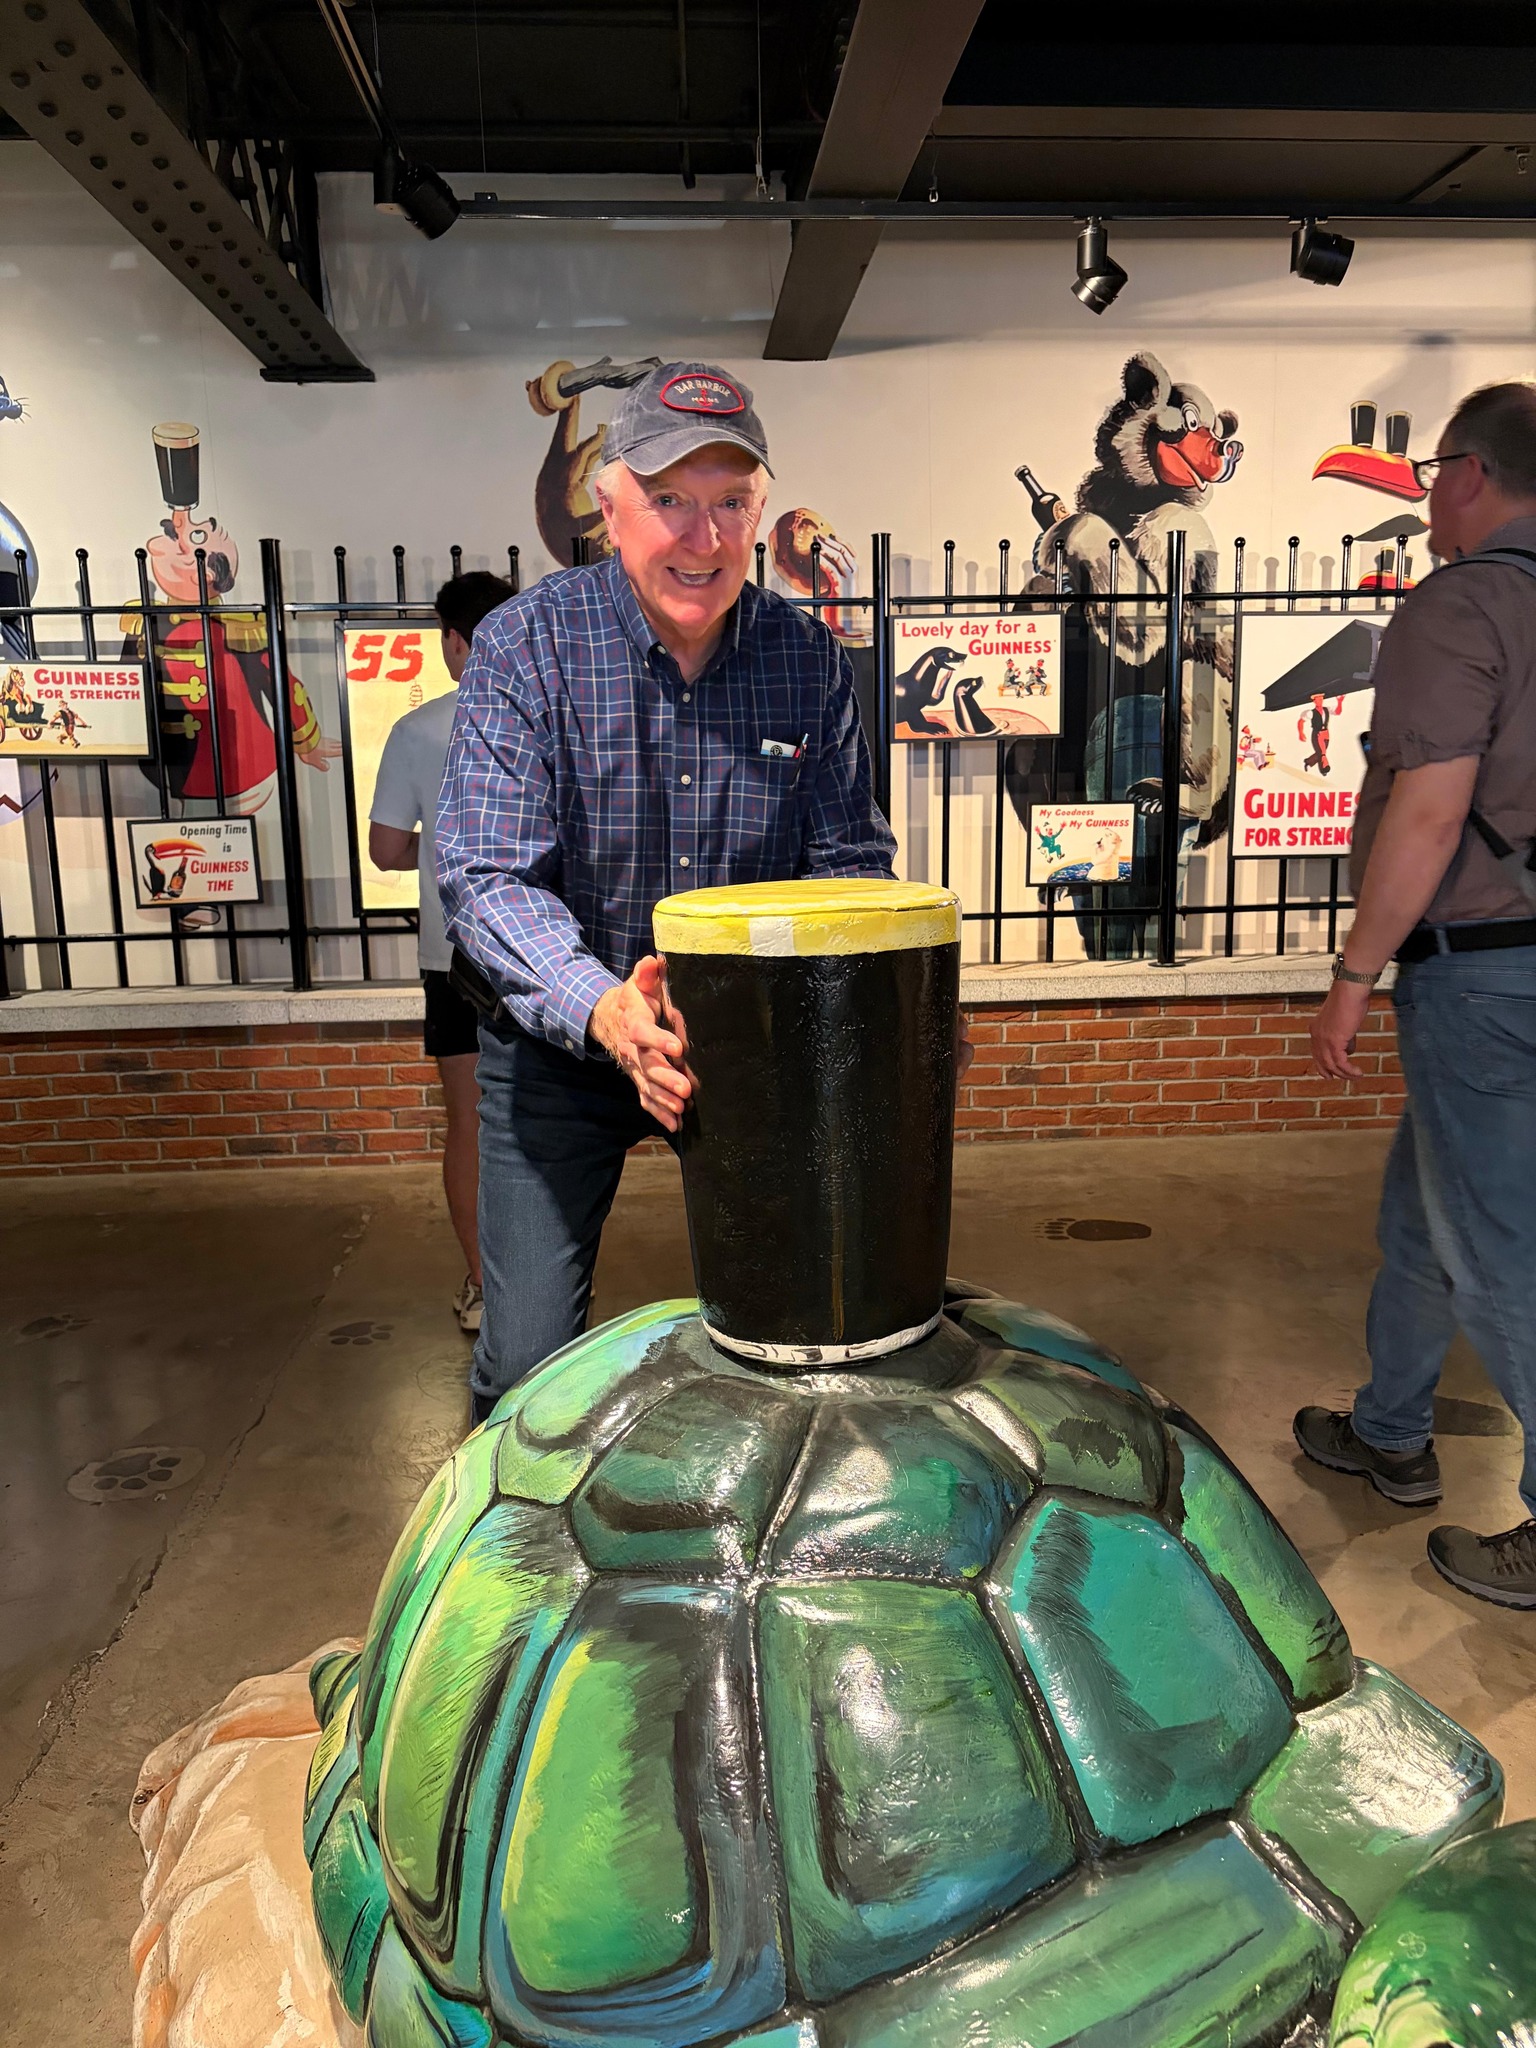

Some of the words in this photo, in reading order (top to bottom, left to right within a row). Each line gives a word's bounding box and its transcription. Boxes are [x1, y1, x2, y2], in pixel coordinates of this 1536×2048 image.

[674, 380, 695, 394] BAR
[695, 380, 731, 397] HARBOR
[901, 621, 954, 639] Lovely
[959, 620, 989, 639] day
[995, 619, 1021, 635] for
[1026, 622, 1037, 634] a
[968, 638, 1052, 656] GUINNESS
[33, 668, 140, 686] GUINNESS
[37, 689, 64, 700] FOR
[69, 689, 141, 700] STRENGTH
[1039, 809, 1052, 819] My
[1055, 808, 1095, 817] Goodness
[180, 825, 222, 839] Opening
[224, 824, 248, 835] Time
[1069, 820, 1082, 830] My
[1085, 818, 1130, 828] GUINNESS
[1244, 827, 1282, 848] FOR
[222, 842, 232, 853] is
[190, 860, 249, 875] GUINNESS
[207, 879, 234, 893] TIME
